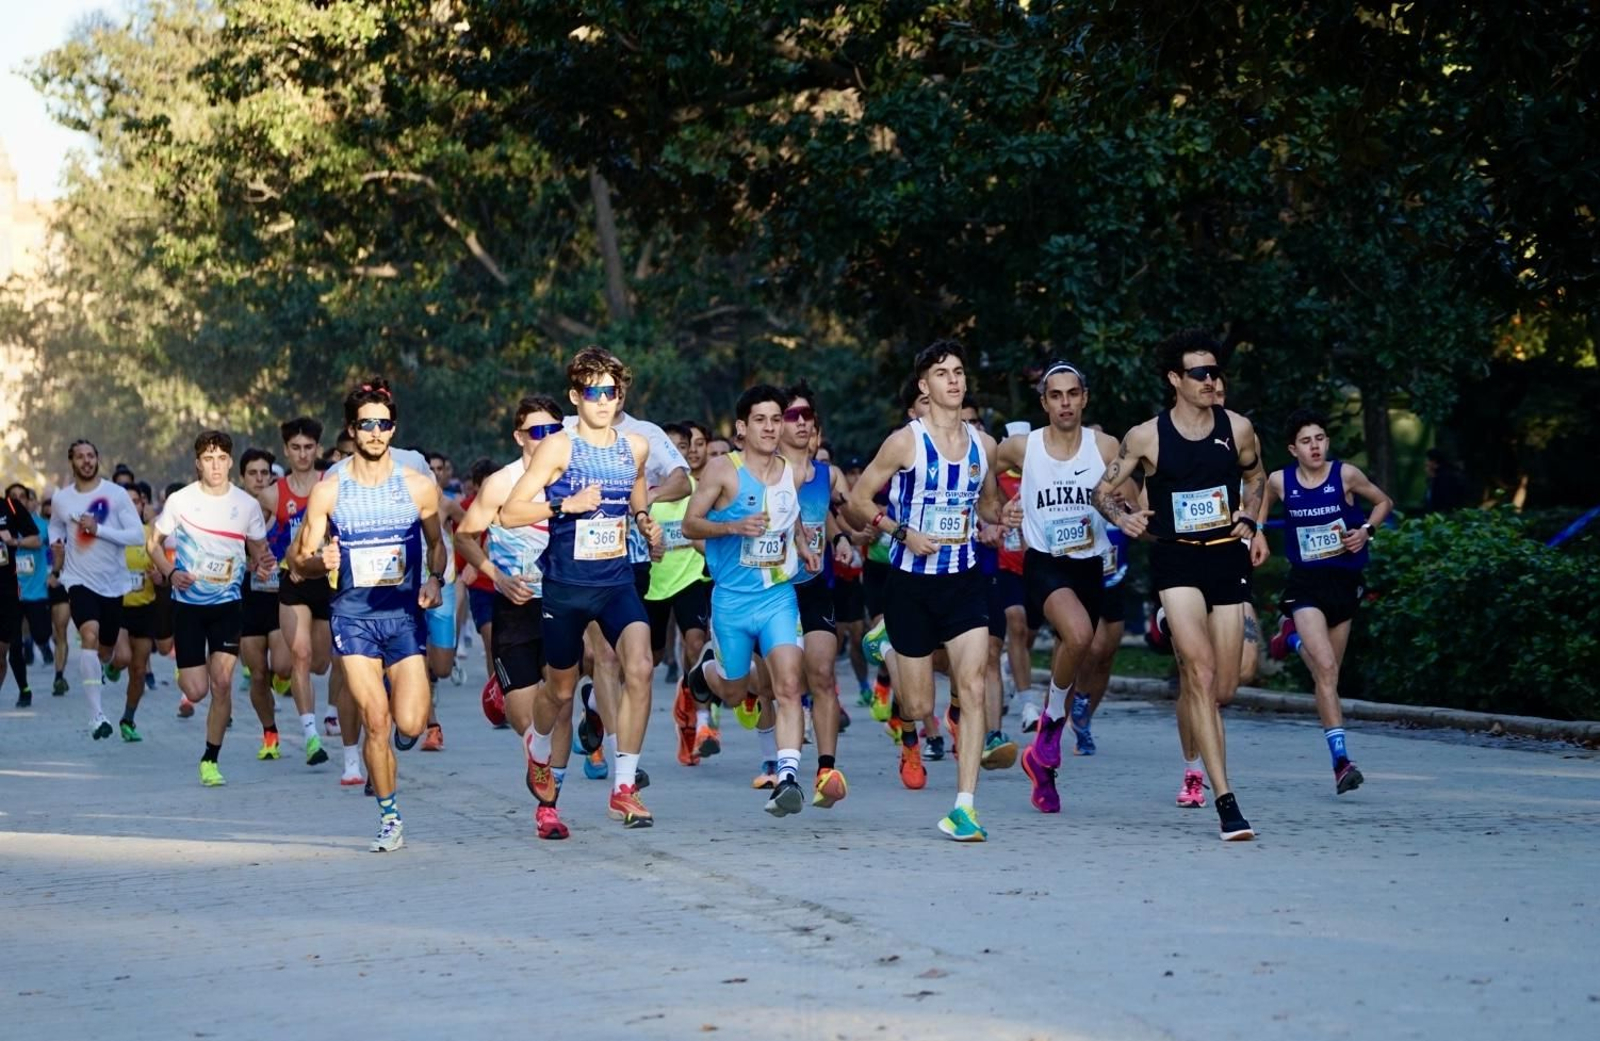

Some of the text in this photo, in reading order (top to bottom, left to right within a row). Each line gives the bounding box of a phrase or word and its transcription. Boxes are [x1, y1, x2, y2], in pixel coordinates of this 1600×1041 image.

[1190, 501, 1214, 516] 698
[1289, 504, 1341, 517] TROTASIERRA
[940, 517, 960, 531] 695
[594, 531, 616, 545] 366
[670, 529, 682, 539] 66
[1056, 526, 1084, 542] 2099
[1310, 533, 1337, 547] 1789
[759, 541, 779, 554] 703
[207, 561, 225, 572] 427
[369, 556, 392, 571] 152
